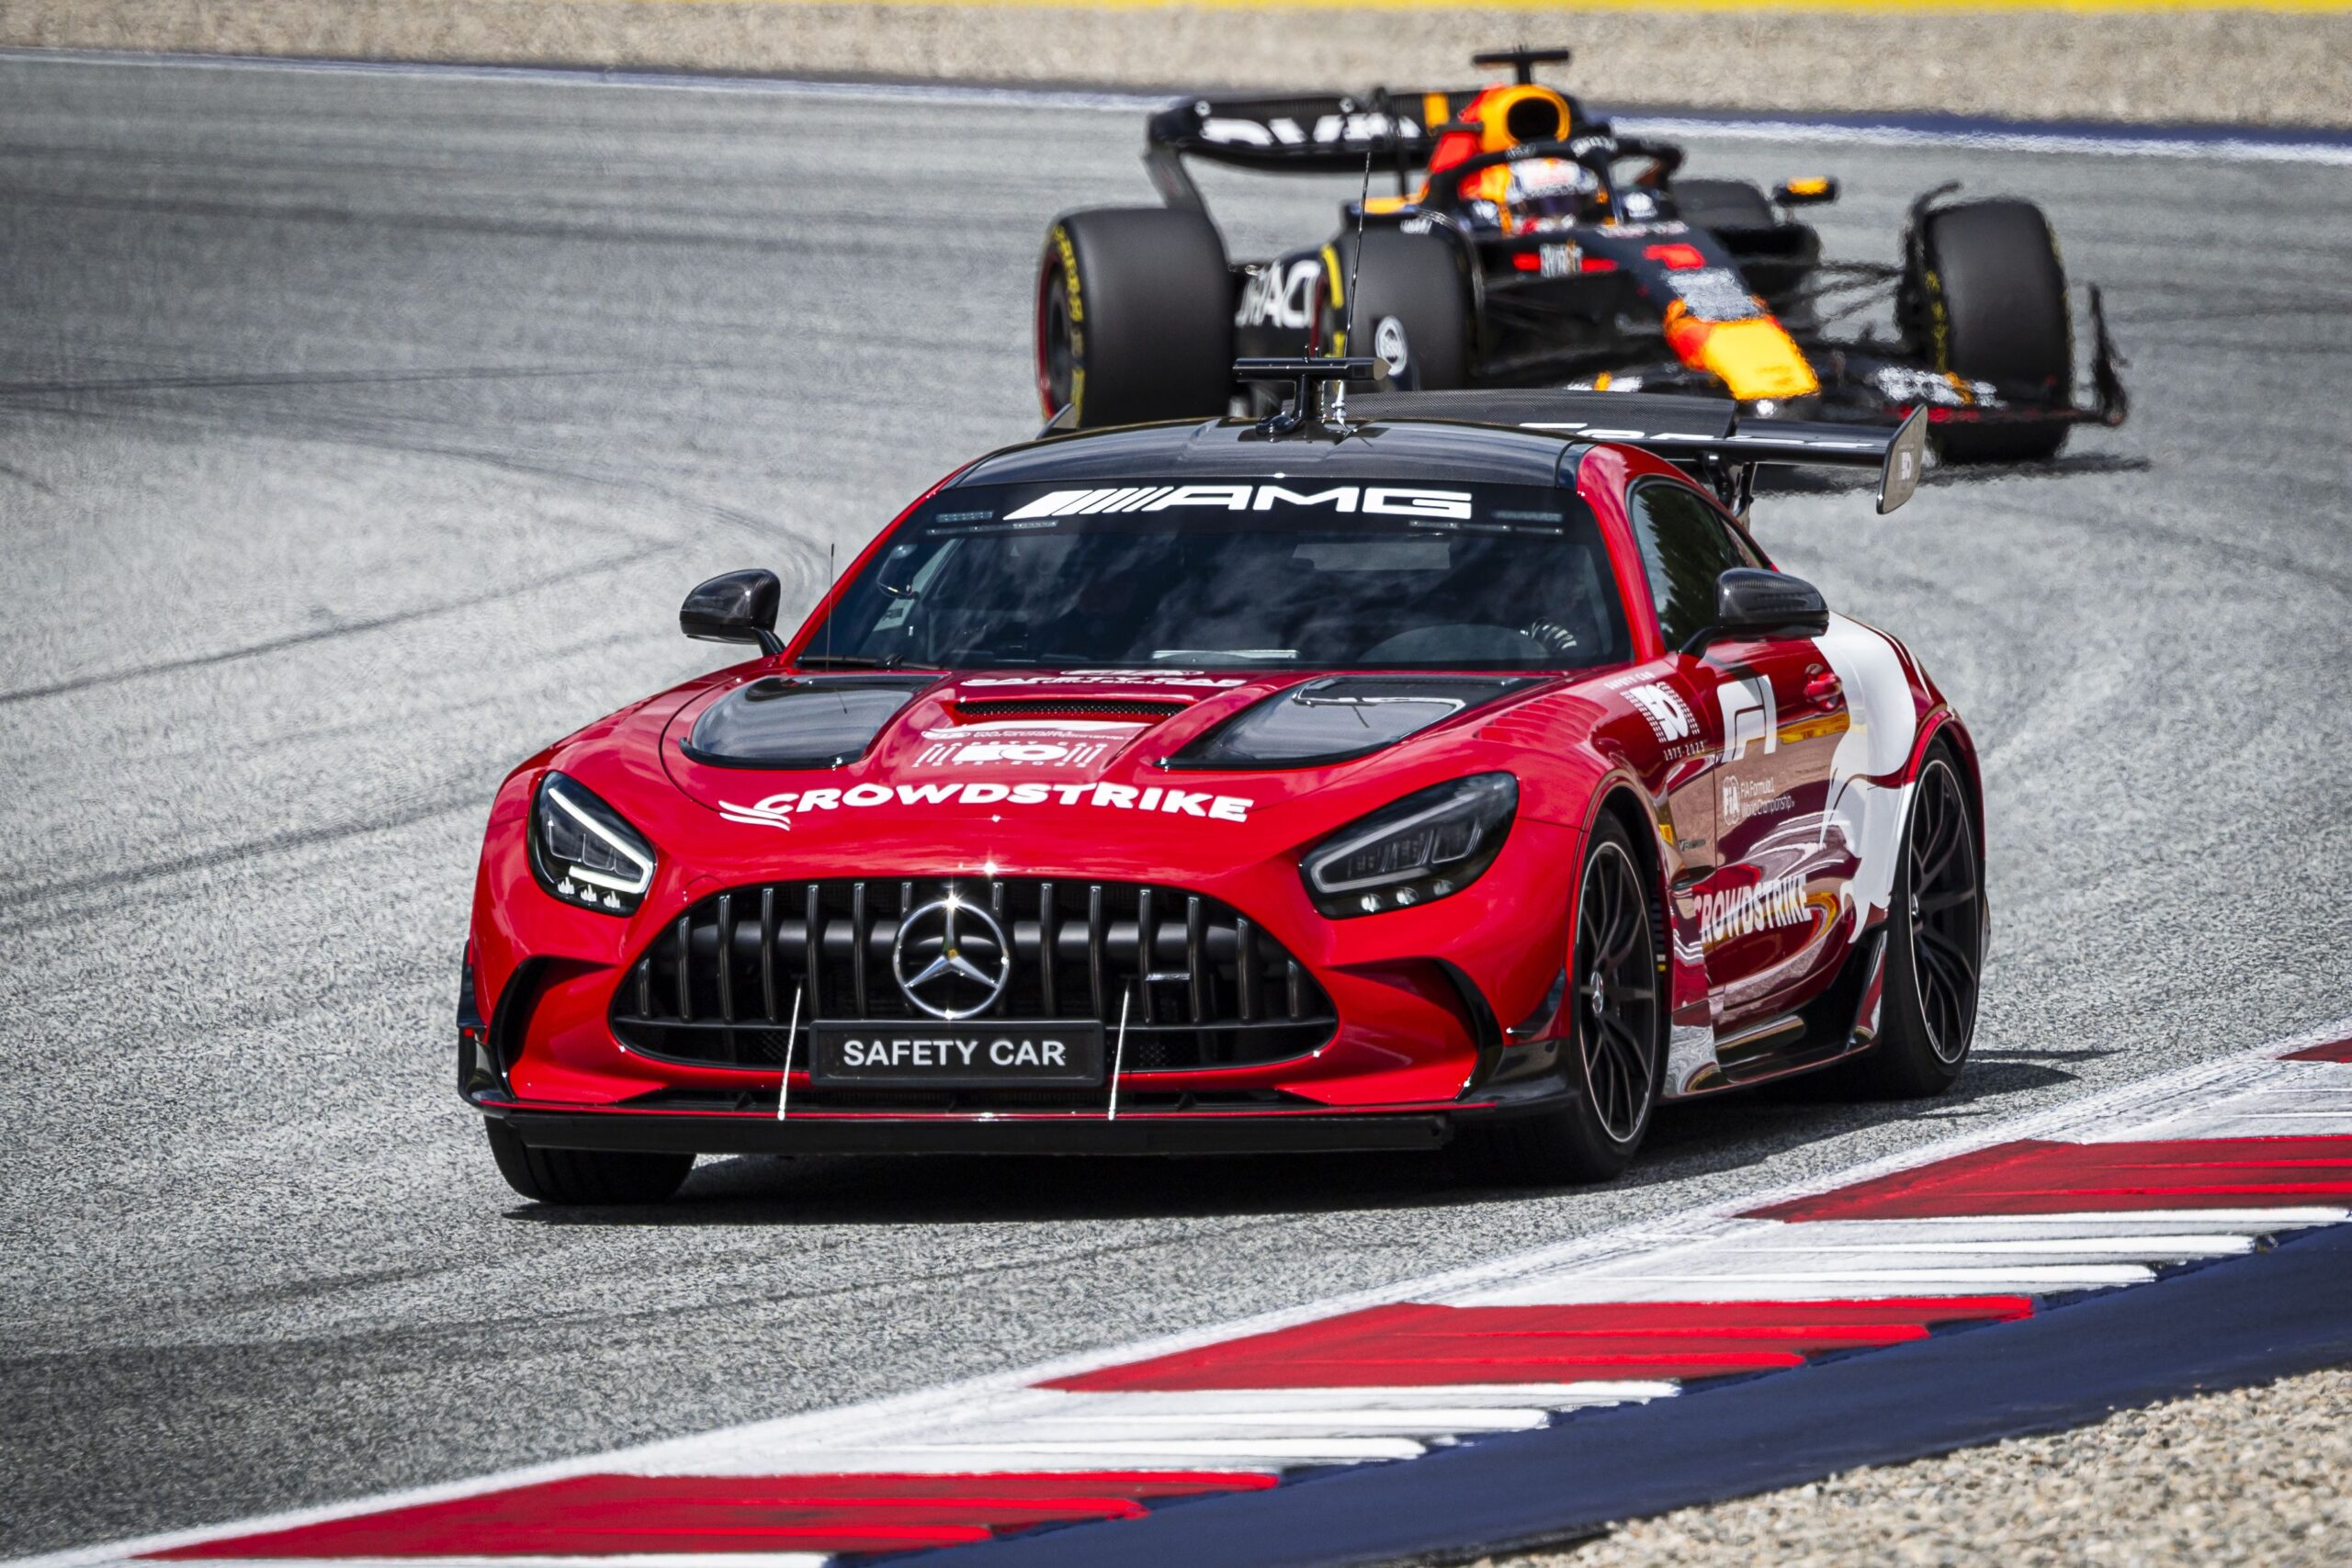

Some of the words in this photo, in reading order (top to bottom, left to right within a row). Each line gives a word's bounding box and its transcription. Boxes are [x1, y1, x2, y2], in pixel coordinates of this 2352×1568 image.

[1141, 485, 1472, 520] AMG
[752, 783, 1255, 823] CROWDSTRIKE
[842, 1040, 978, 1066] SAFETY
[989, 1040, 1067, 1066] CAR
